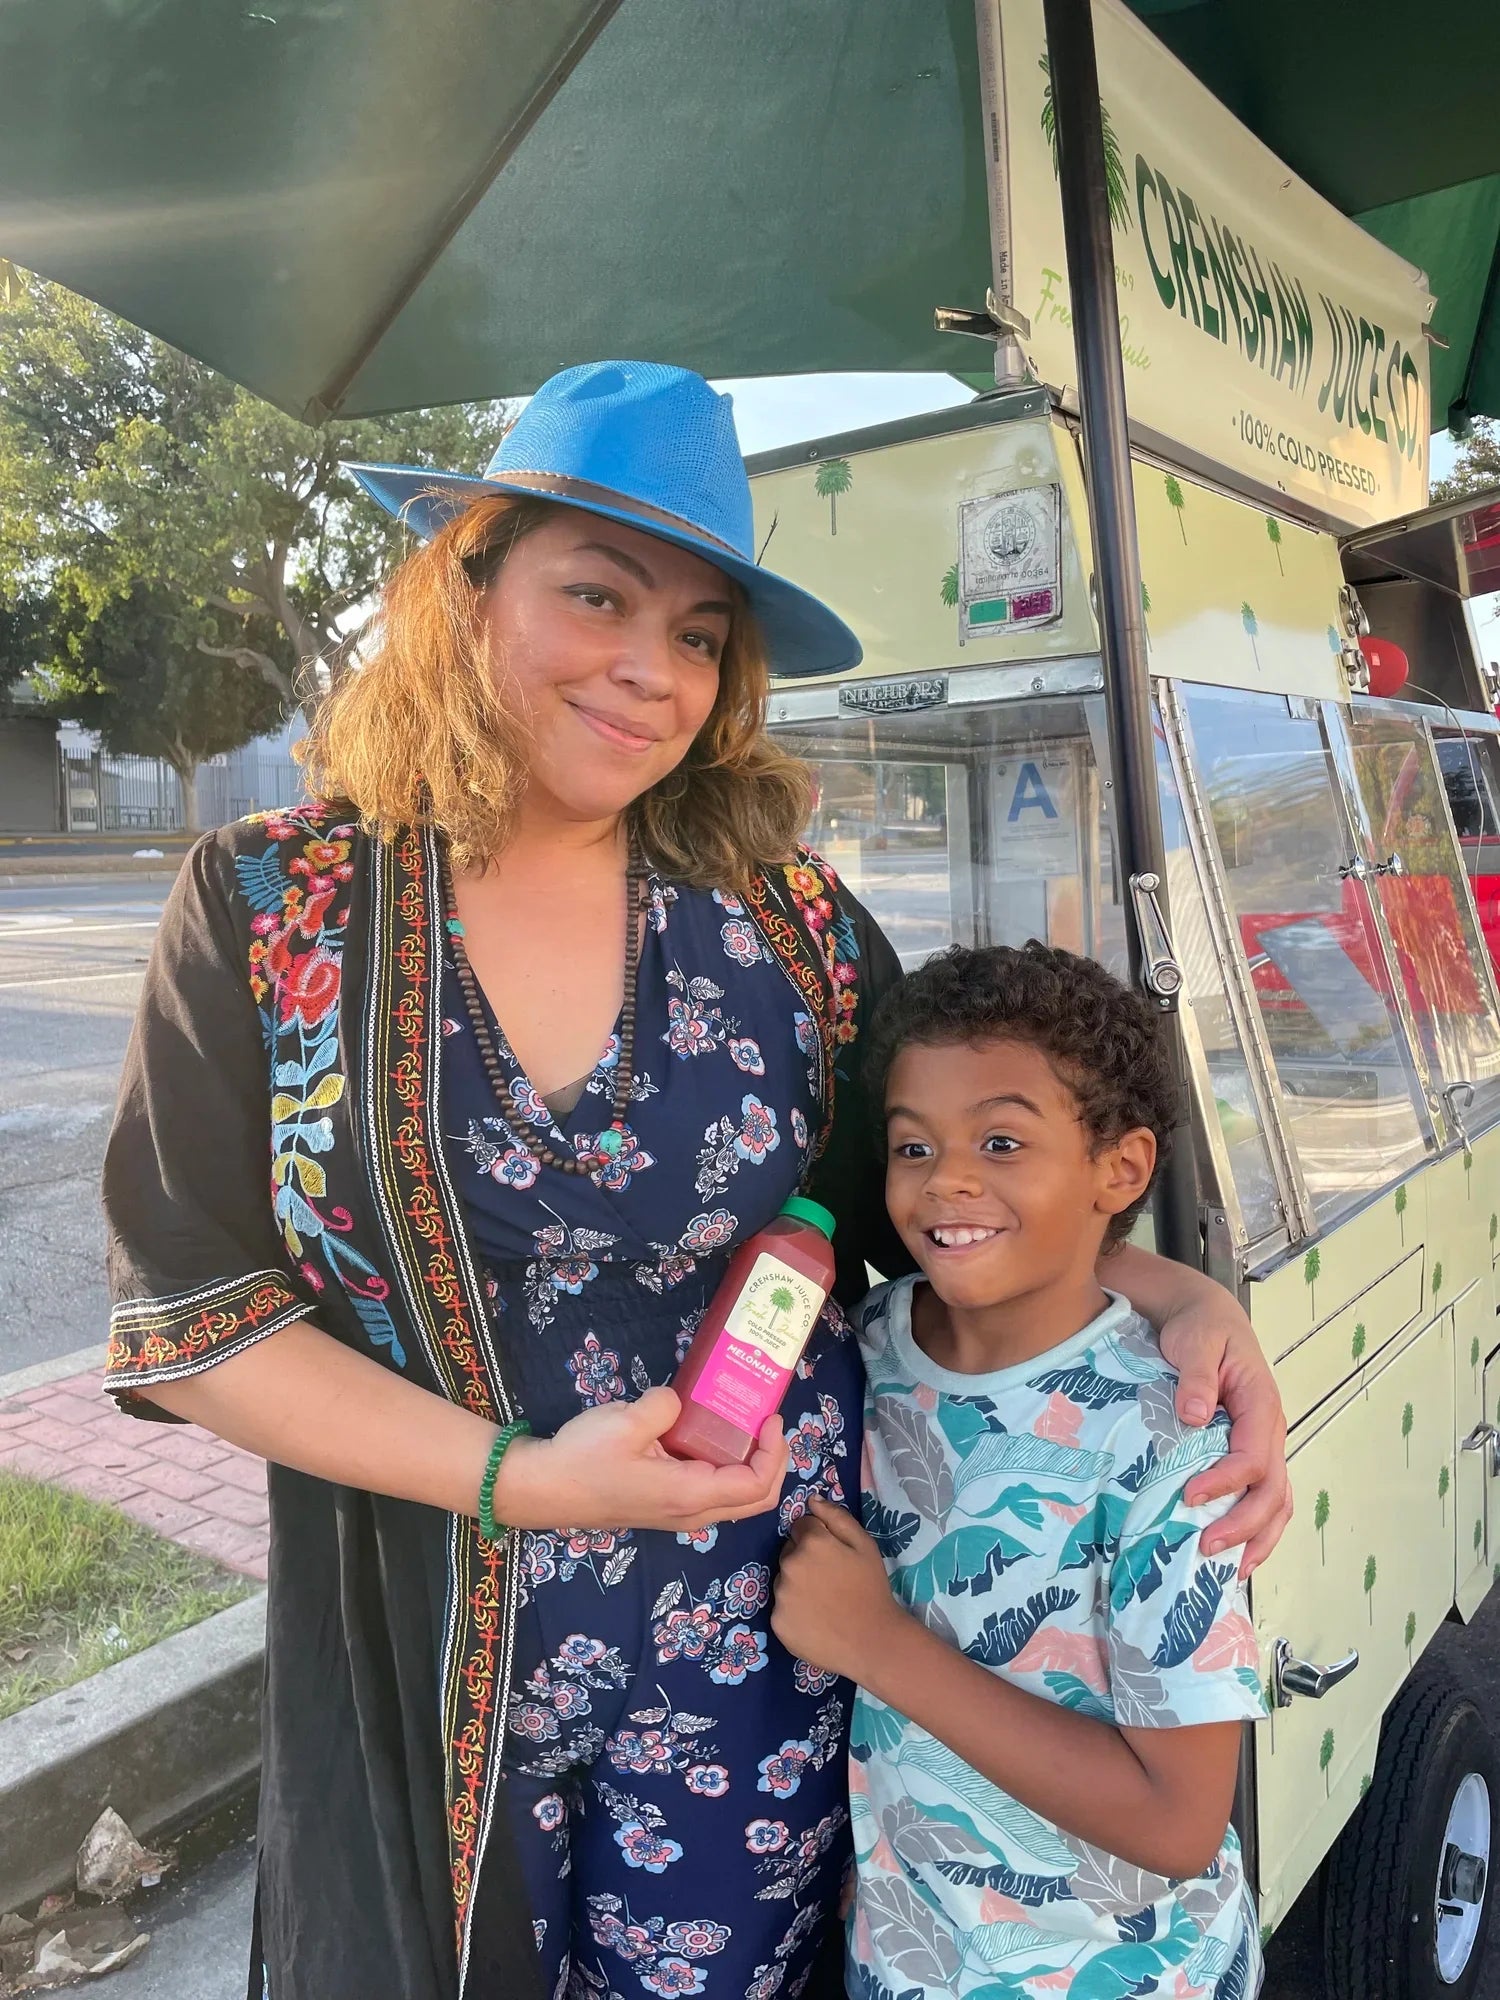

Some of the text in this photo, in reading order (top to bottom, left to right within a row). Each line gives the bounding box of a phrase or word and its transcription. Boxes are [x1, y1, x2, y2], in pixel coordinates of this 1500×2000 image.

[1000, 251, 1009, 273] Made
[1001, 279, 1010, 290] in
[1115, 265, 1134, 291] 969
[1035, 268, 1071, 328] Fres
[1135, 153, 1314, 399] CRENSHAW
[1317, 291, 1388, 443] JUICE
[1386, 340, 1422, 471] CO.
[1240, 410, 1376, 496] 100% COLD PRESSED
[844, 680, 943, 704] NEIGHBORS
[1007, 762, 1058, 822] A
[749, 1273, 794, 1293] CRENSHAW
[794, 1285, 811, 1309] JUICE
[801, 1313, 811, 1328] CO.
[748, 1320, 787, 1347] COLD PRESSED
[764, 1338, 780, 1350] JUICE
[727, 1344, 780, 1380] MELONADE
